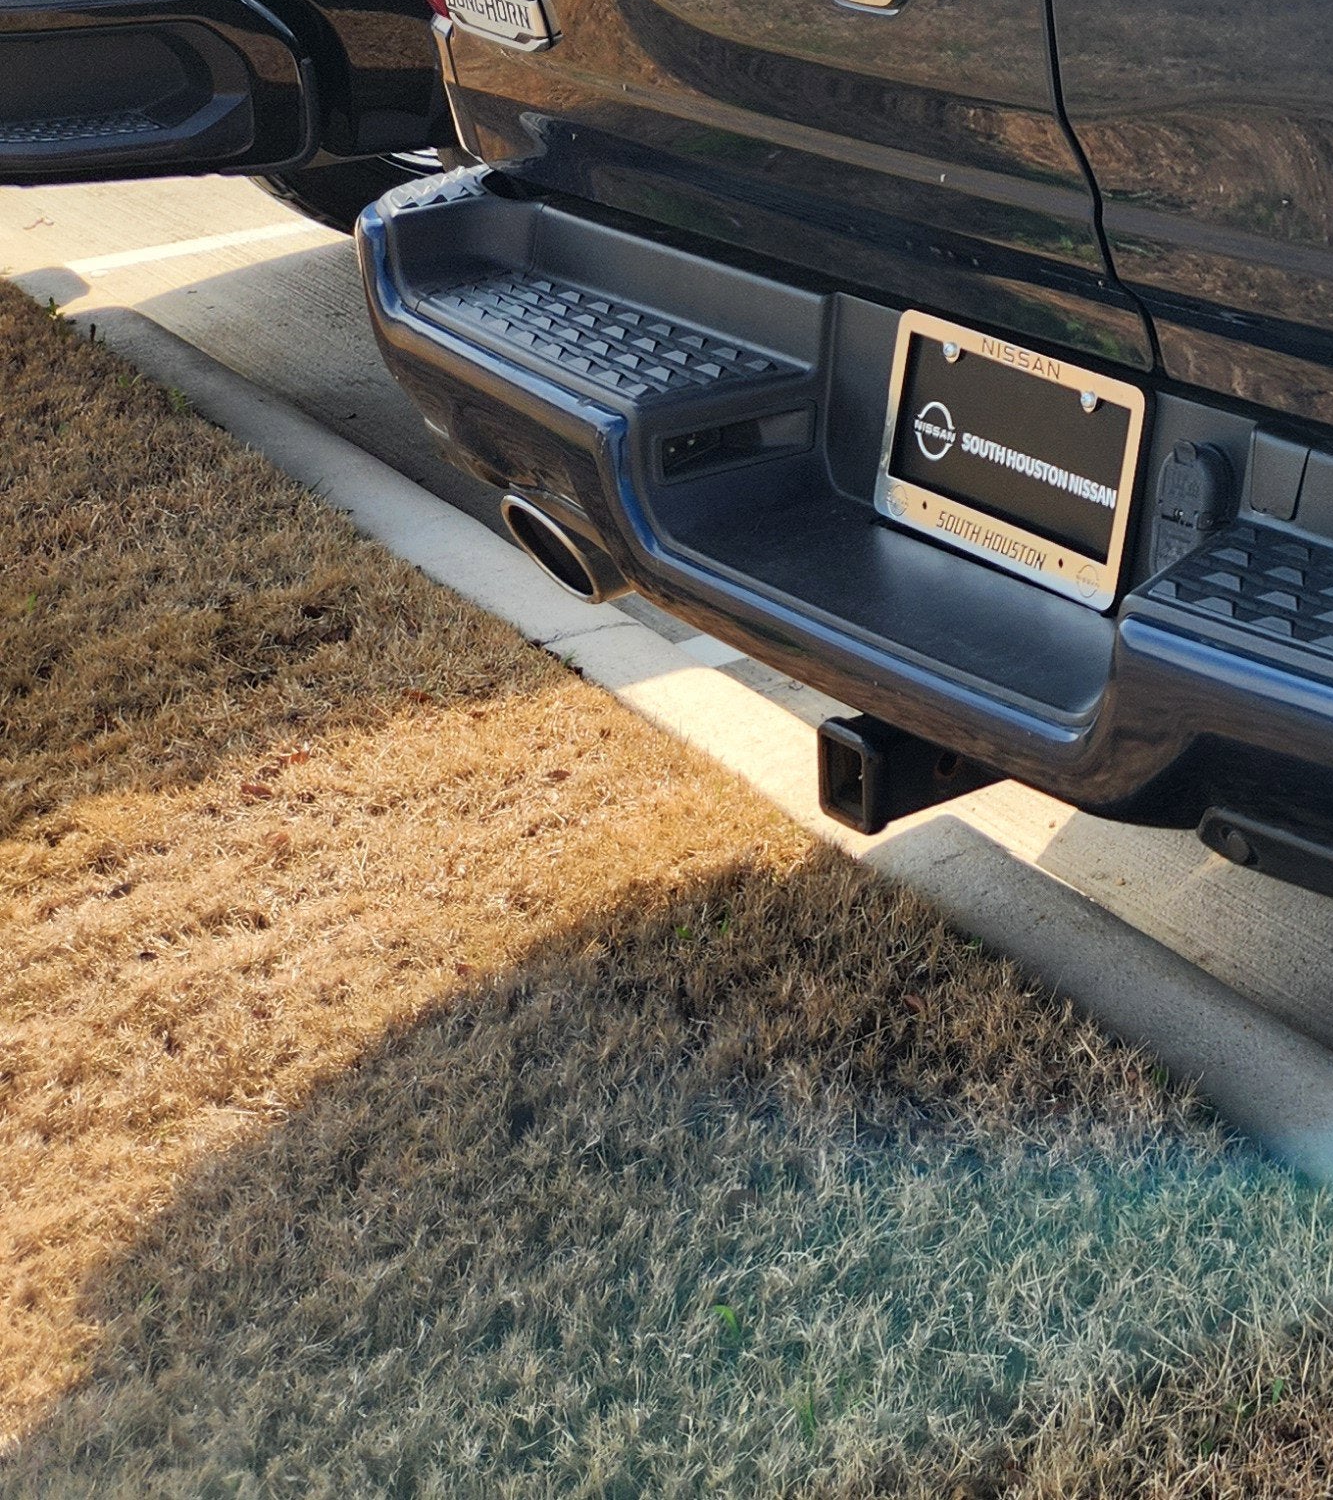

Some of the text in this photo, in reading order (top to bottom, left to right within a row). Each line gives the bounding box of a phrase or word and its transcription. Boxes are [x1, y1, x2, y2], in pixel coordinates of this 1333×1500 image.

[981, 337, 1061, 380] NISSAN
[914, 418, 956, 443] NISSAN
[961, 432, 1117, 509] SOUTH HOUSTON NISSAN
[936, 510, 1047, 571] SOUTH HOUSTON
